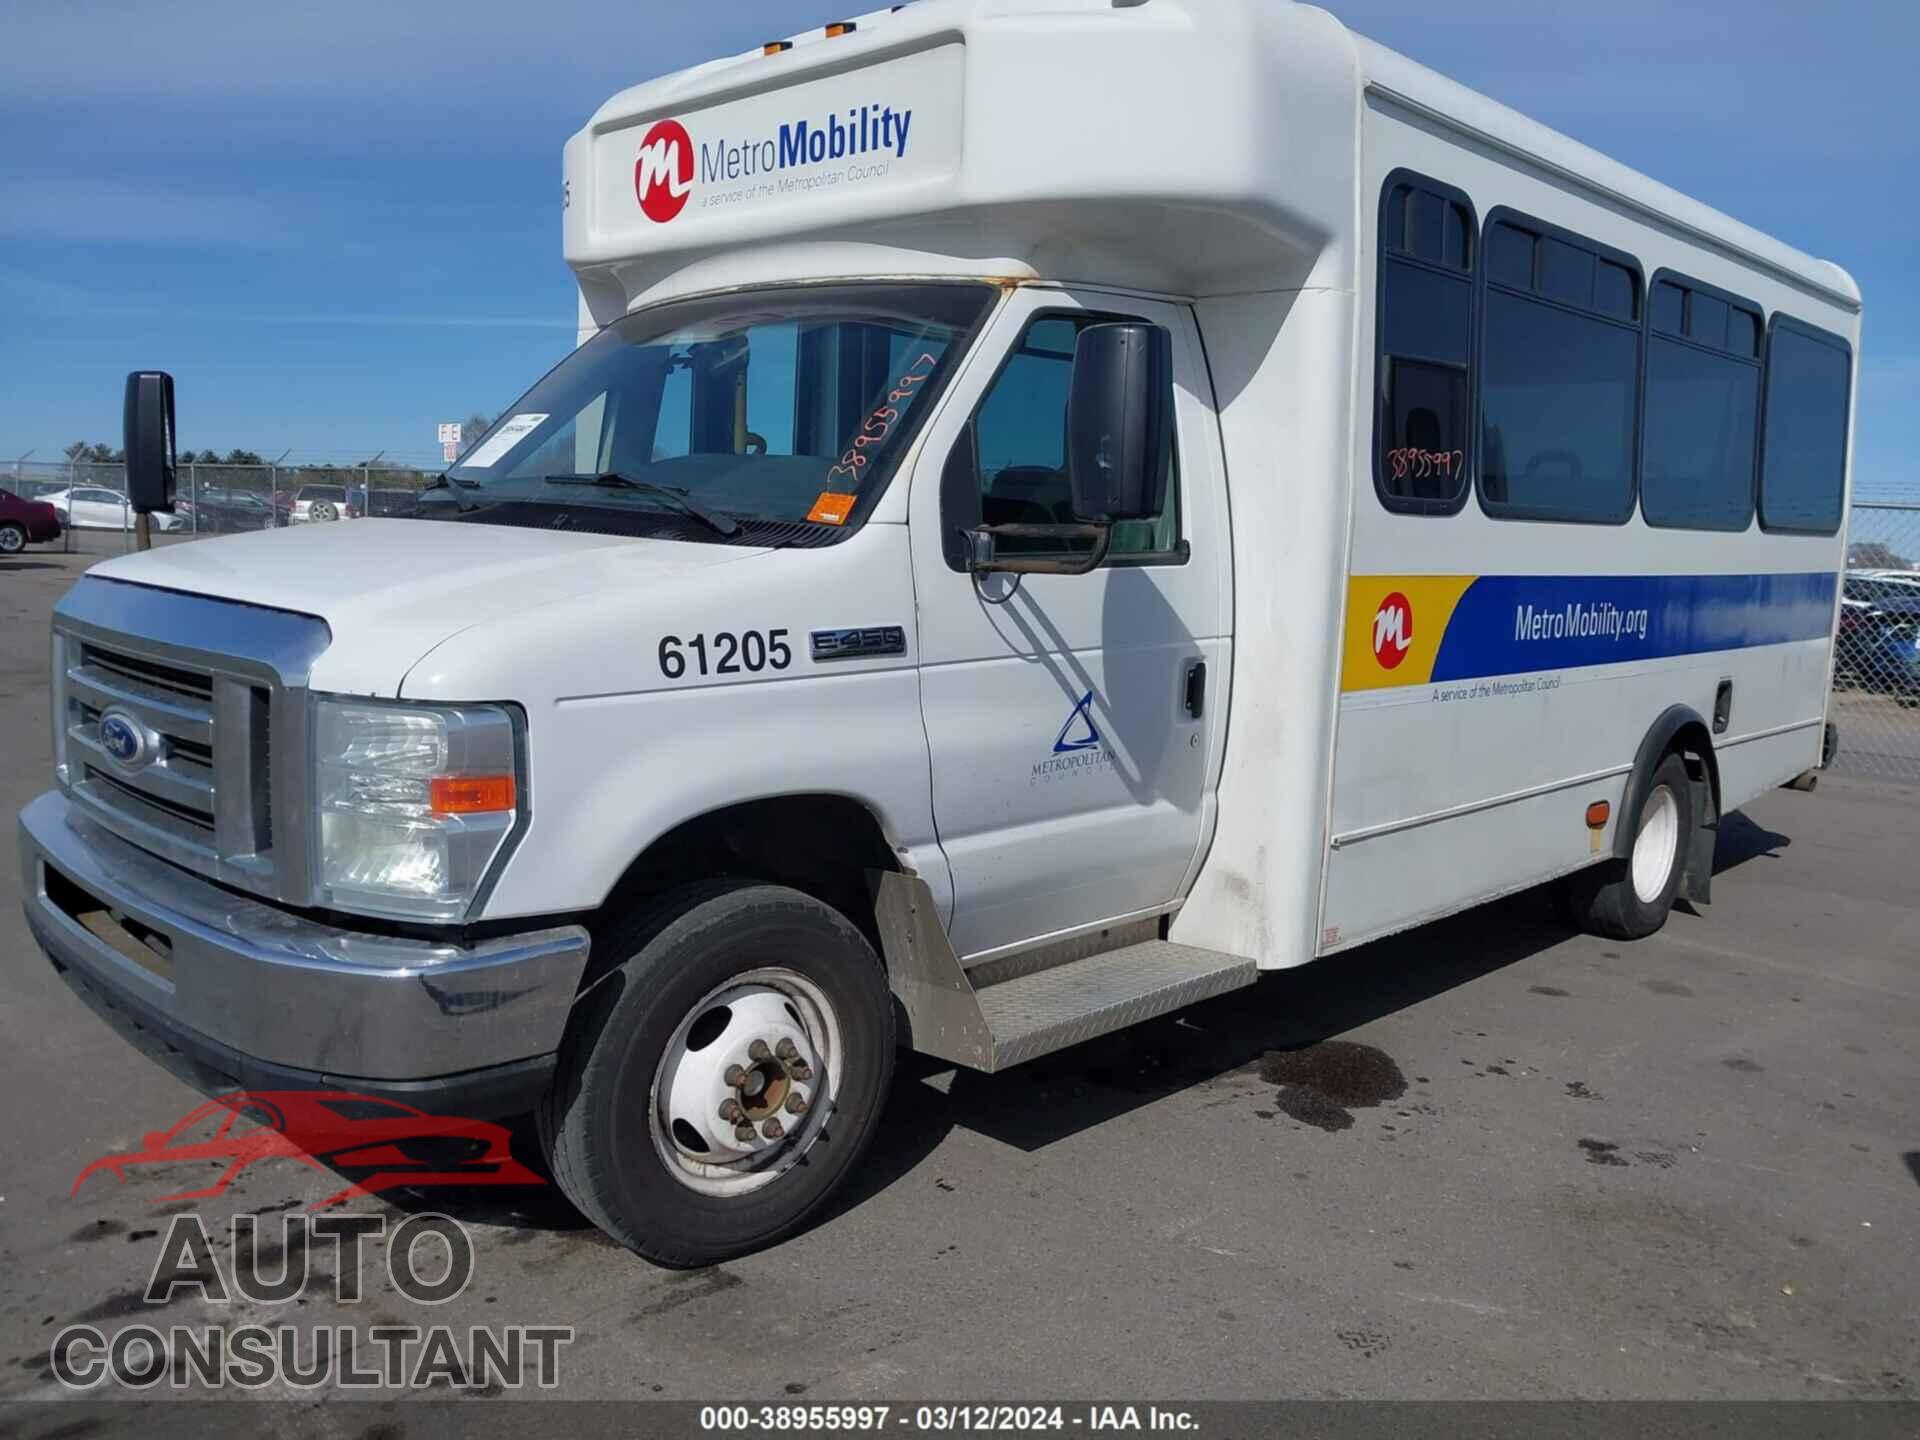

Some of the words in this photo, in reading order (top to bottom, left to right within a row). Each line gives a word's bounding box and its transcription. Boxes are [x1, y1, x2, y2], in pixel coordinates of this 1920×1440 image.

[701, 196, 708, 208] a
[709, 189, 743, 205] service
[745, 186, 758, 200] of
[759, 182, 775, 198] the
[777, 169, 845, 193] Metropolitan
[847, 159, 890, 182] Council
[826, 353, 937, 484] 38955997
[1387, 447, 1463, 481] 38955997
[1514, 602, 1648, 642] MetroMobility.org
[658, 628, 792, 679] 61205
[1432, 688, 1440, 702] A
[1440, 687, 1467, 702] service
[1469, 683, 1479, 699] of
[1479, 682, 1491, 698] the
[1492, 679, 1536, 699] Metropolitan
[1537, 675, 1561, 691] Council
[1032, 751, 1116, 776] METROPOLITAN
